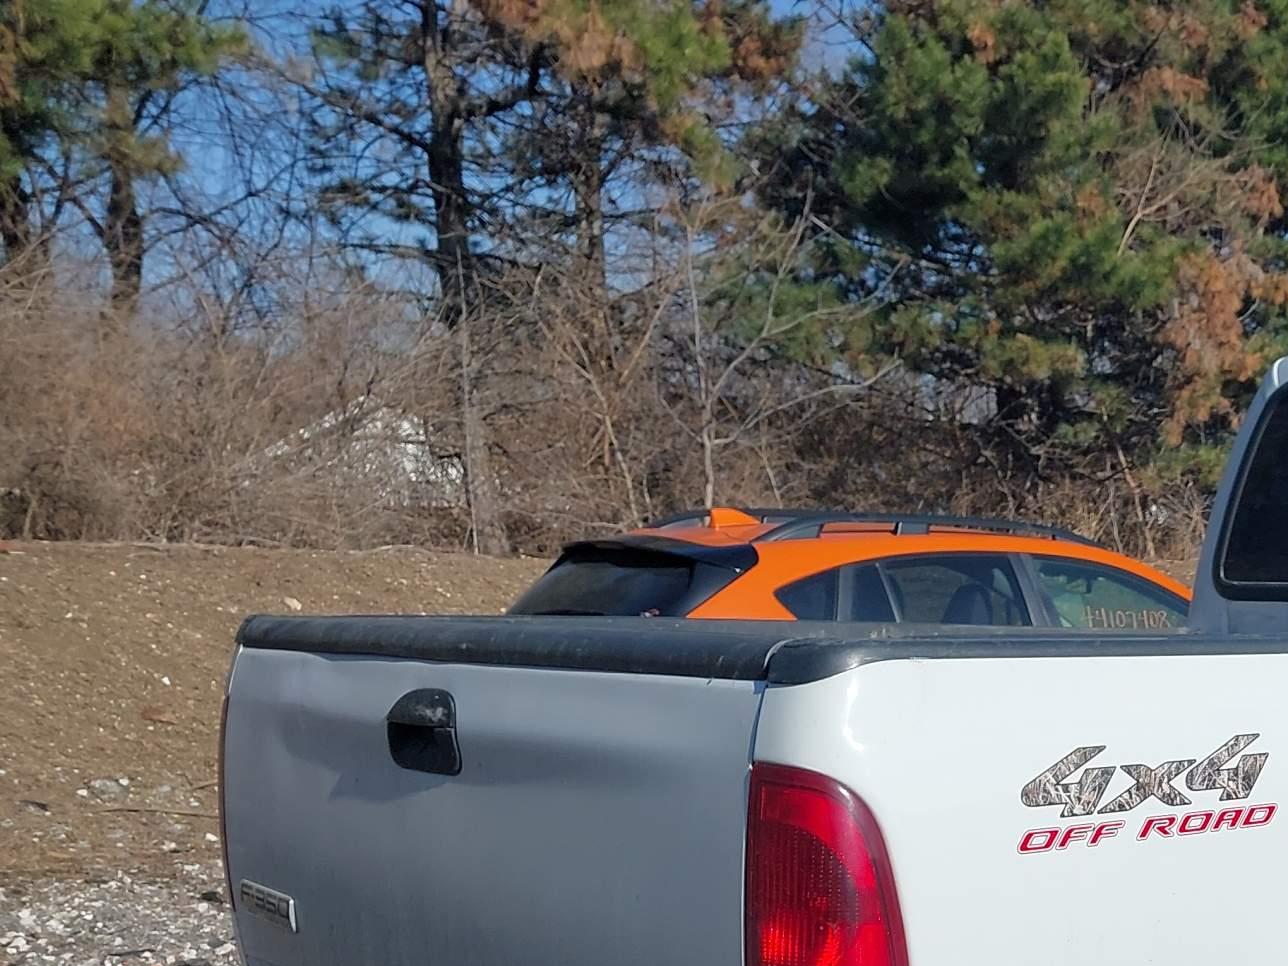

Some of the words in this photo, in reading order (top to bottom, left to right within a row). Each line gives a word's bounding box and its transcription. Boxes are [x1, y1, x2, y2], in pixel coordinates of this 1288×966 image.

[1021, 733, 1269, 818] 4x4
[1017, 820, 1126, 854] OFF
[1136, 803, 1279, 841] ROAD
